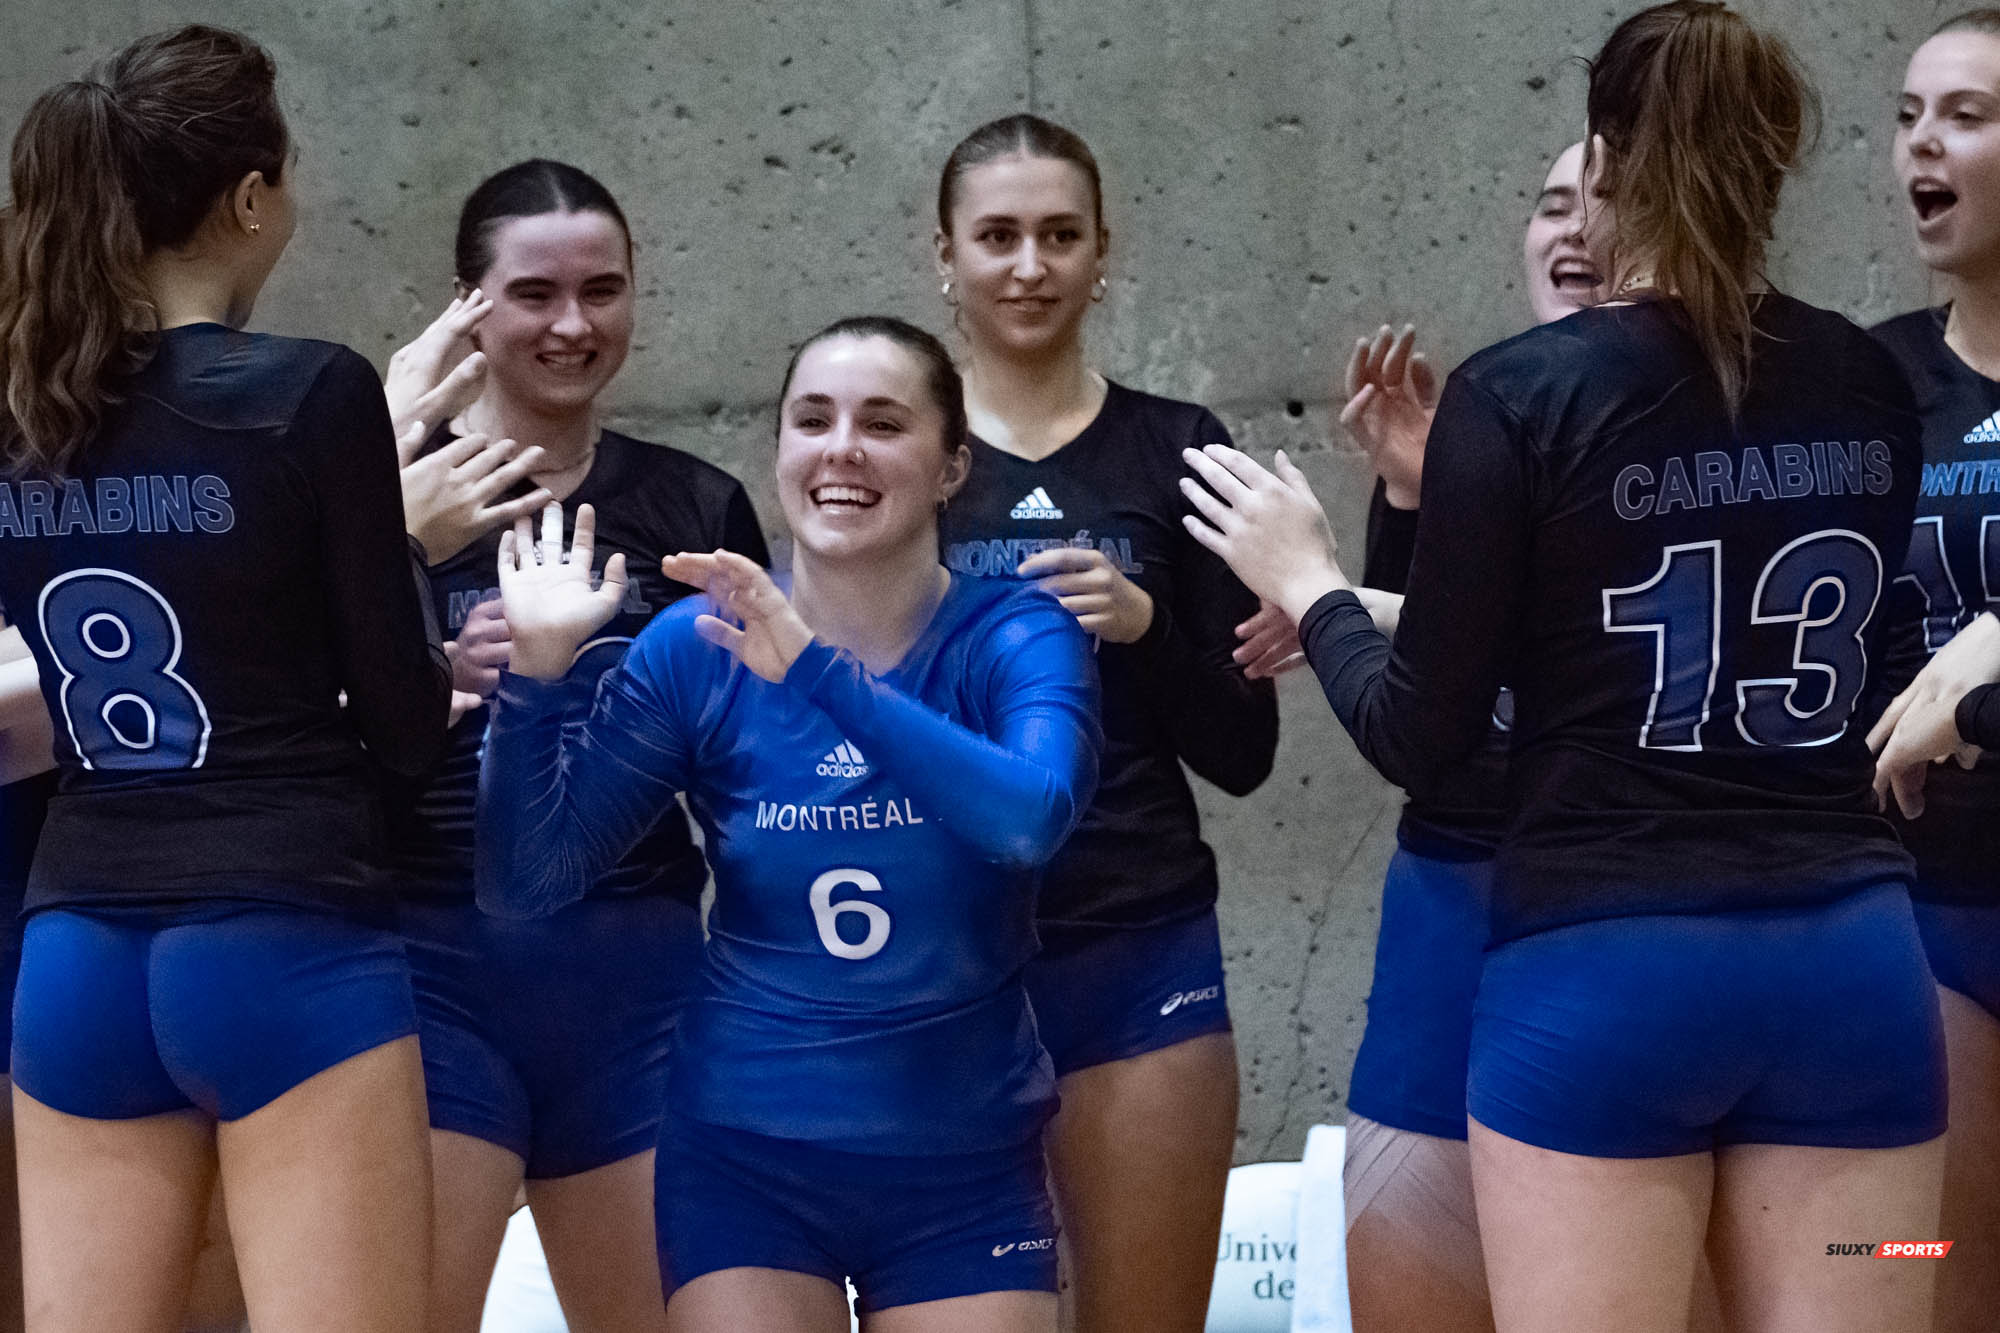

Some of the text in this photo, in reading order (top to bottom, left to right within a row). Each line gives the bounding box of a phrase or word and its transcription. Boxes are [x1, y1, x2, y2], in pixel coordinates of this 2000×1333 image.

[1613, 440, 1893, 521] CARABINS
[1010, 508, 1064, 520] adidas
[38, 567, 212, 770] 8
[1602, 528, 1883, 752] 13
[816, 762, 870, 779] adidas
[755, 796, 924, 832] MONTRÉAL
[809, 868, 891, 960] 6
[1254, 1271, 1295, 1300] de
